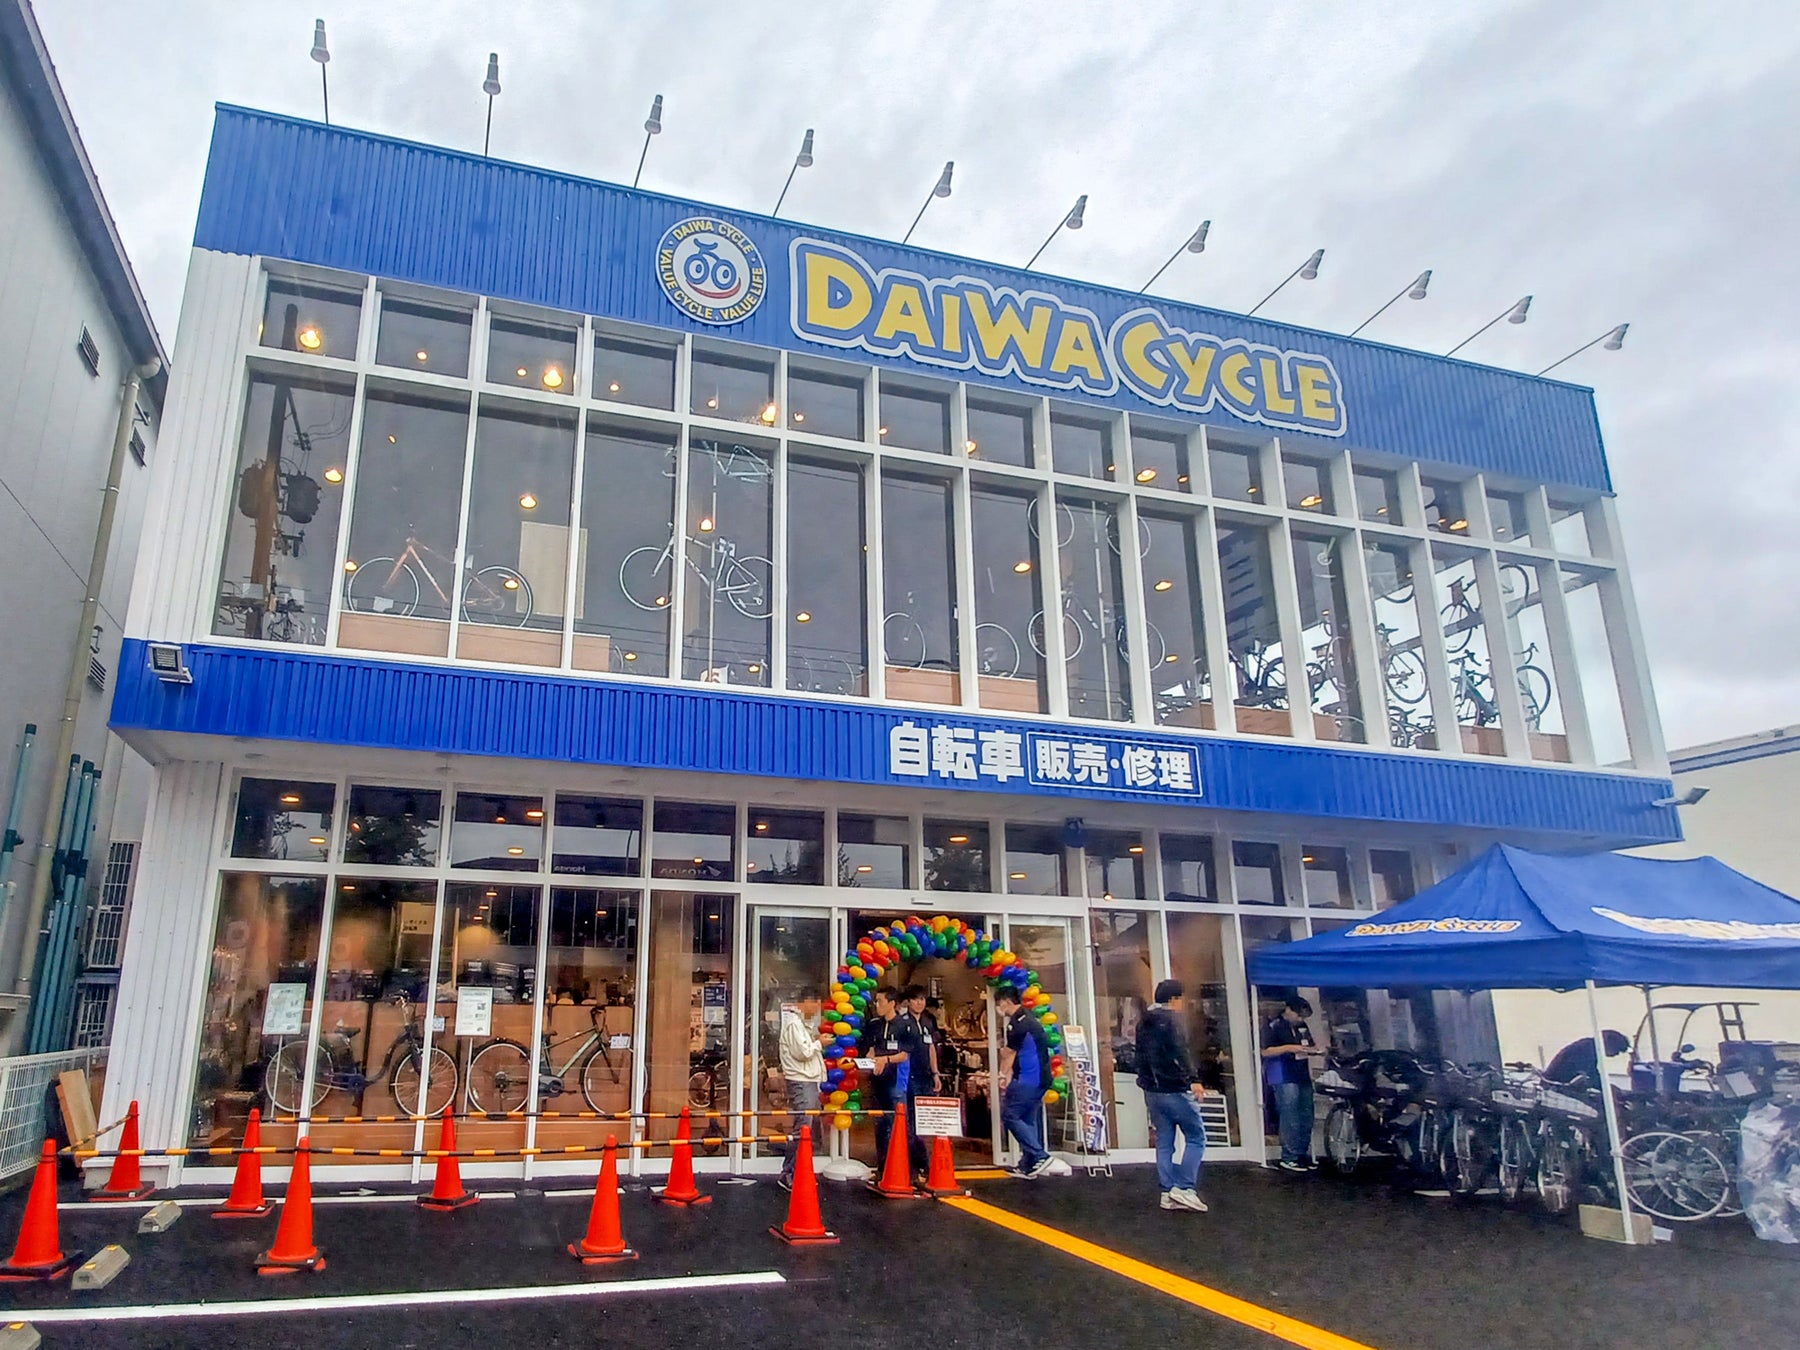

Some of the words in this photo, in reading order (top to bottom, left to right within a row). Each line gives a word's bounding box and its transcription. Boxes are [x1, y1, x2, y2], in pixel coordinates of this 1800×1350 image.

[672, 220, 714, 240] DAIWA
[718, 224, 753, 254] CYCLE
[660, 248, 676, 289] VALUE
[720, 295, 757, 320] VALUE
[750, 267, 763, 296] LIFE
[805, 252, 1105, 381] DAIWA
[1121, 321, 1336, 423] CYCLE
[889, 721, 1025, 782] 自転車
[1035, 738, 1194, 790] 販売・修理
